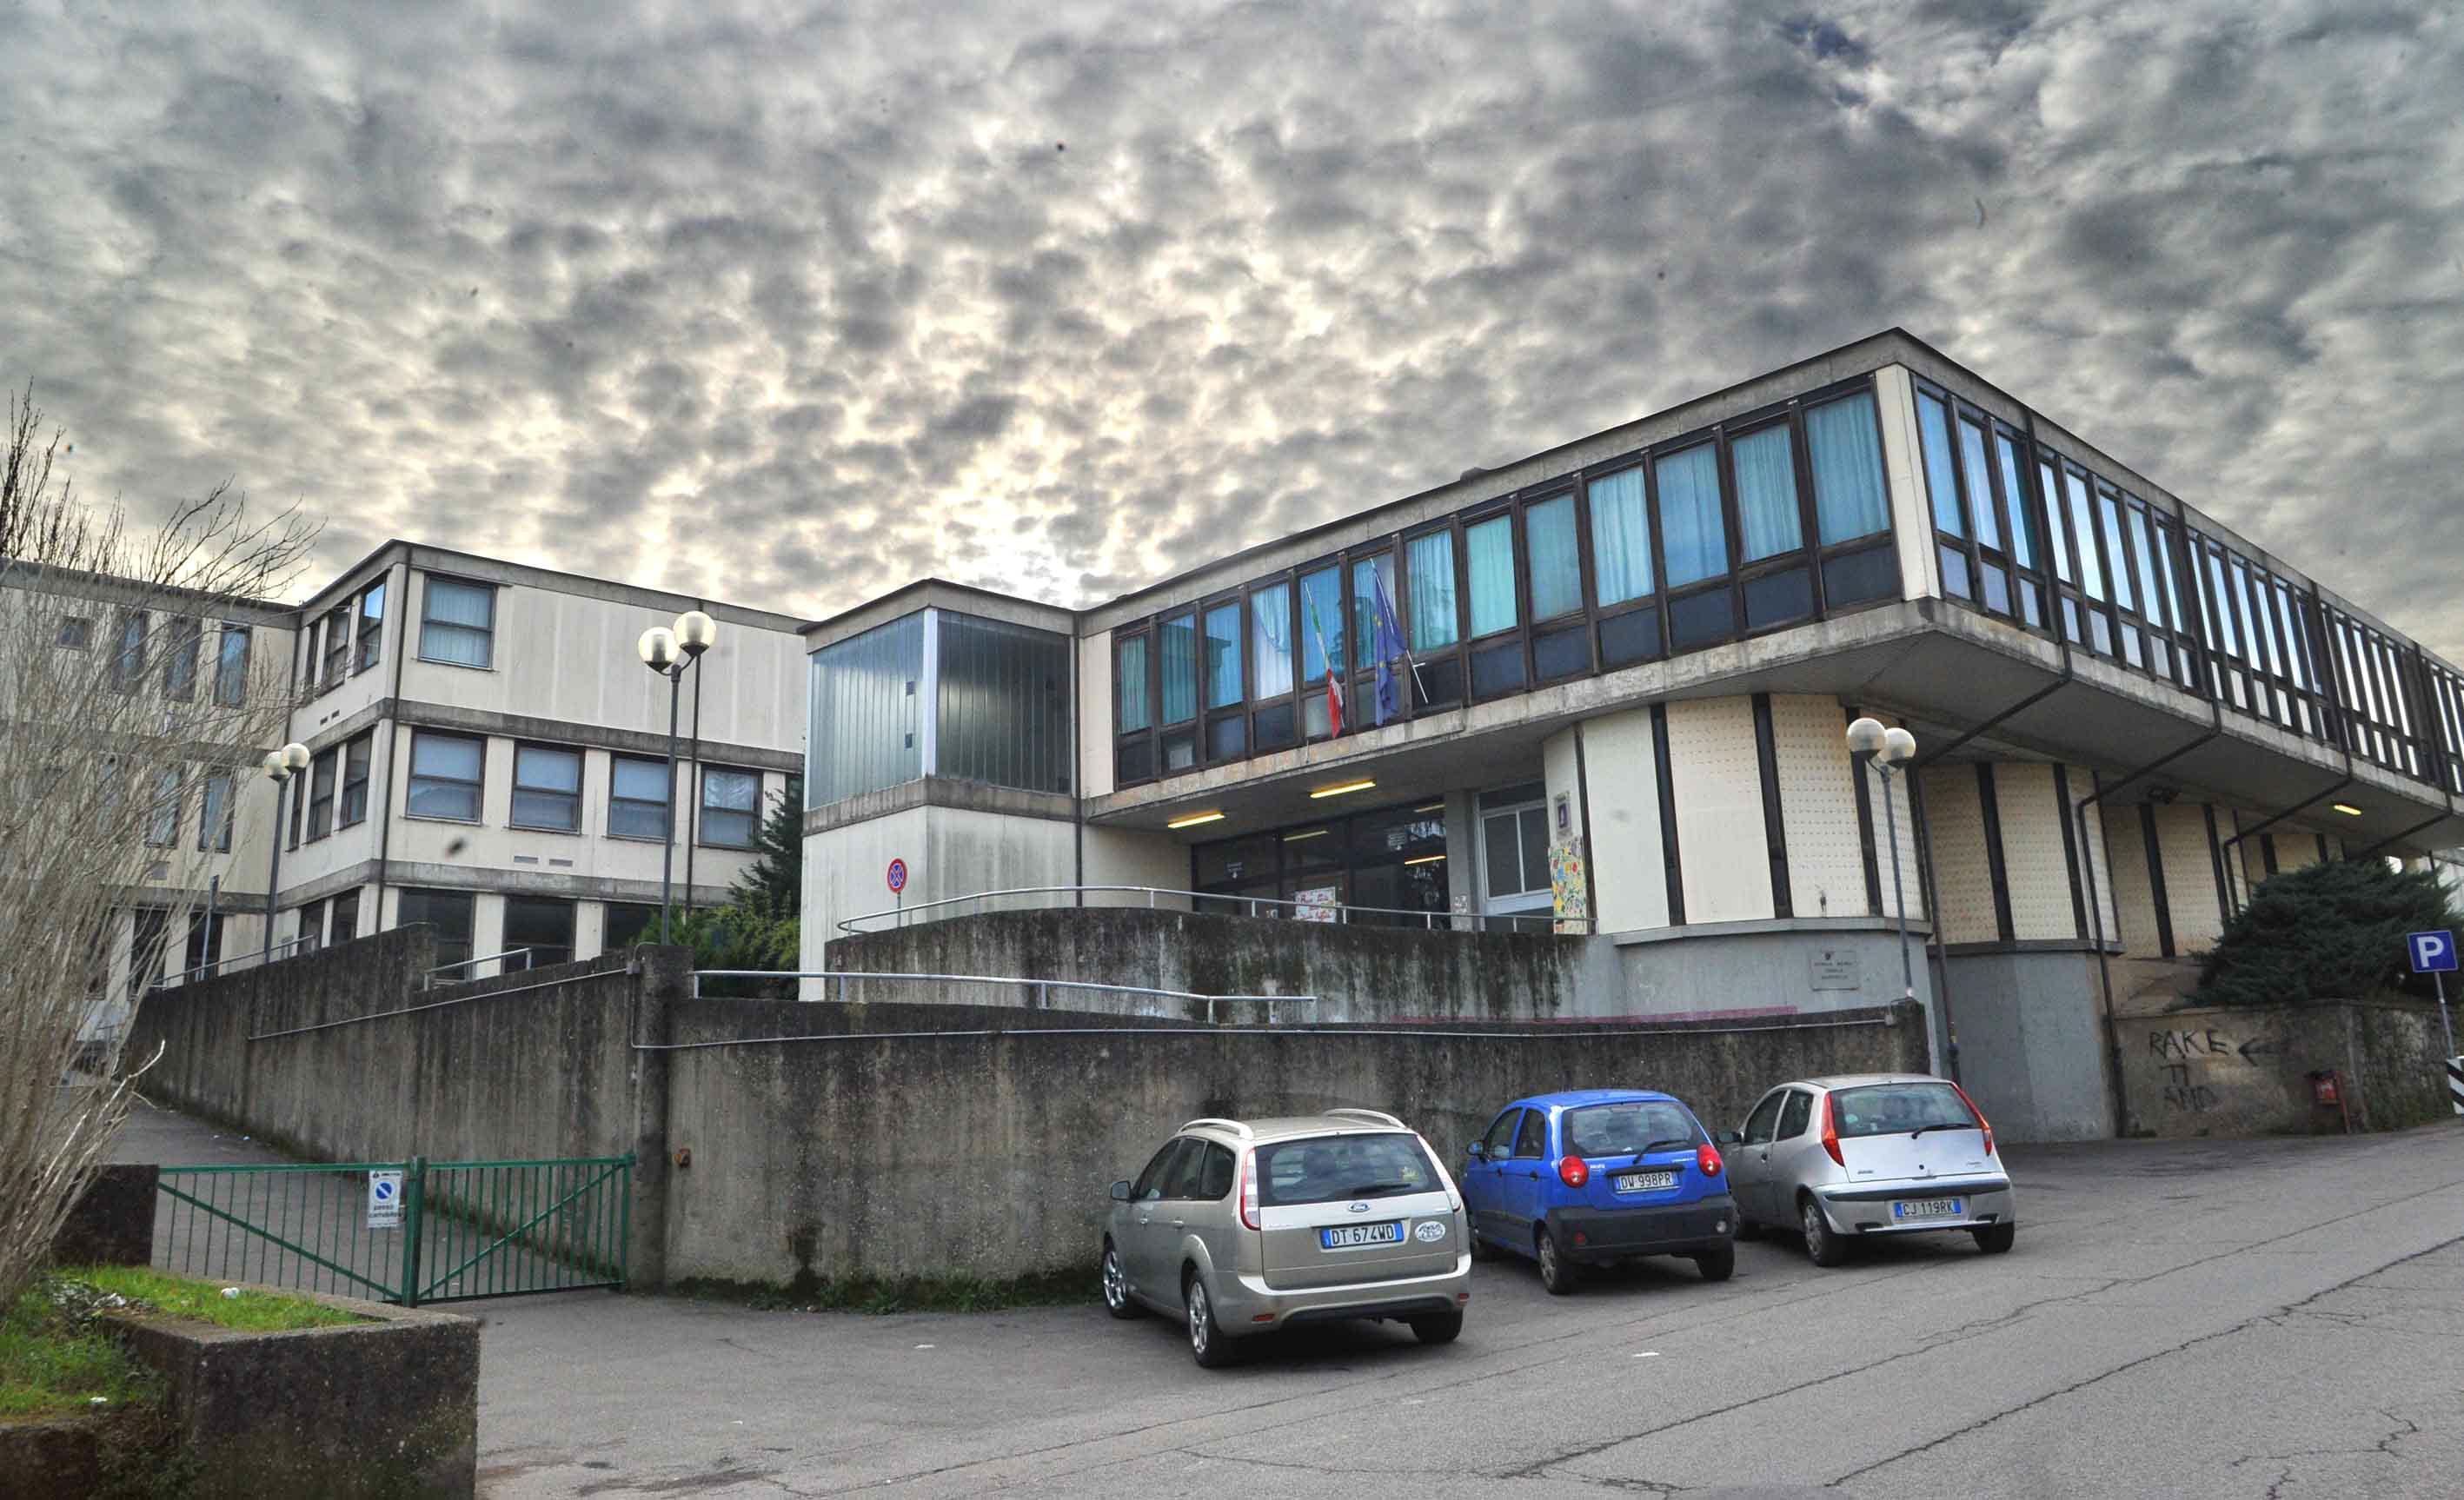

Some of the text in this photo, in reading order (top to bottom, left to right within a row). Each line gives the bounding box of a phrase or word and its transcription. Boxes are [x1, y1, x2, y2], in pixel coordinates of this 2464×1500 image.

[2416, 936, 2444, 967] P
[2149, 1028, 2229, 1059] RAKE
[1620, 1172, 1672, 1190] DW 998PR
[1903, 1200, 1954, 1215] CJ 119RK
[1331, 1224, 1395, 1245] DT 674WD
